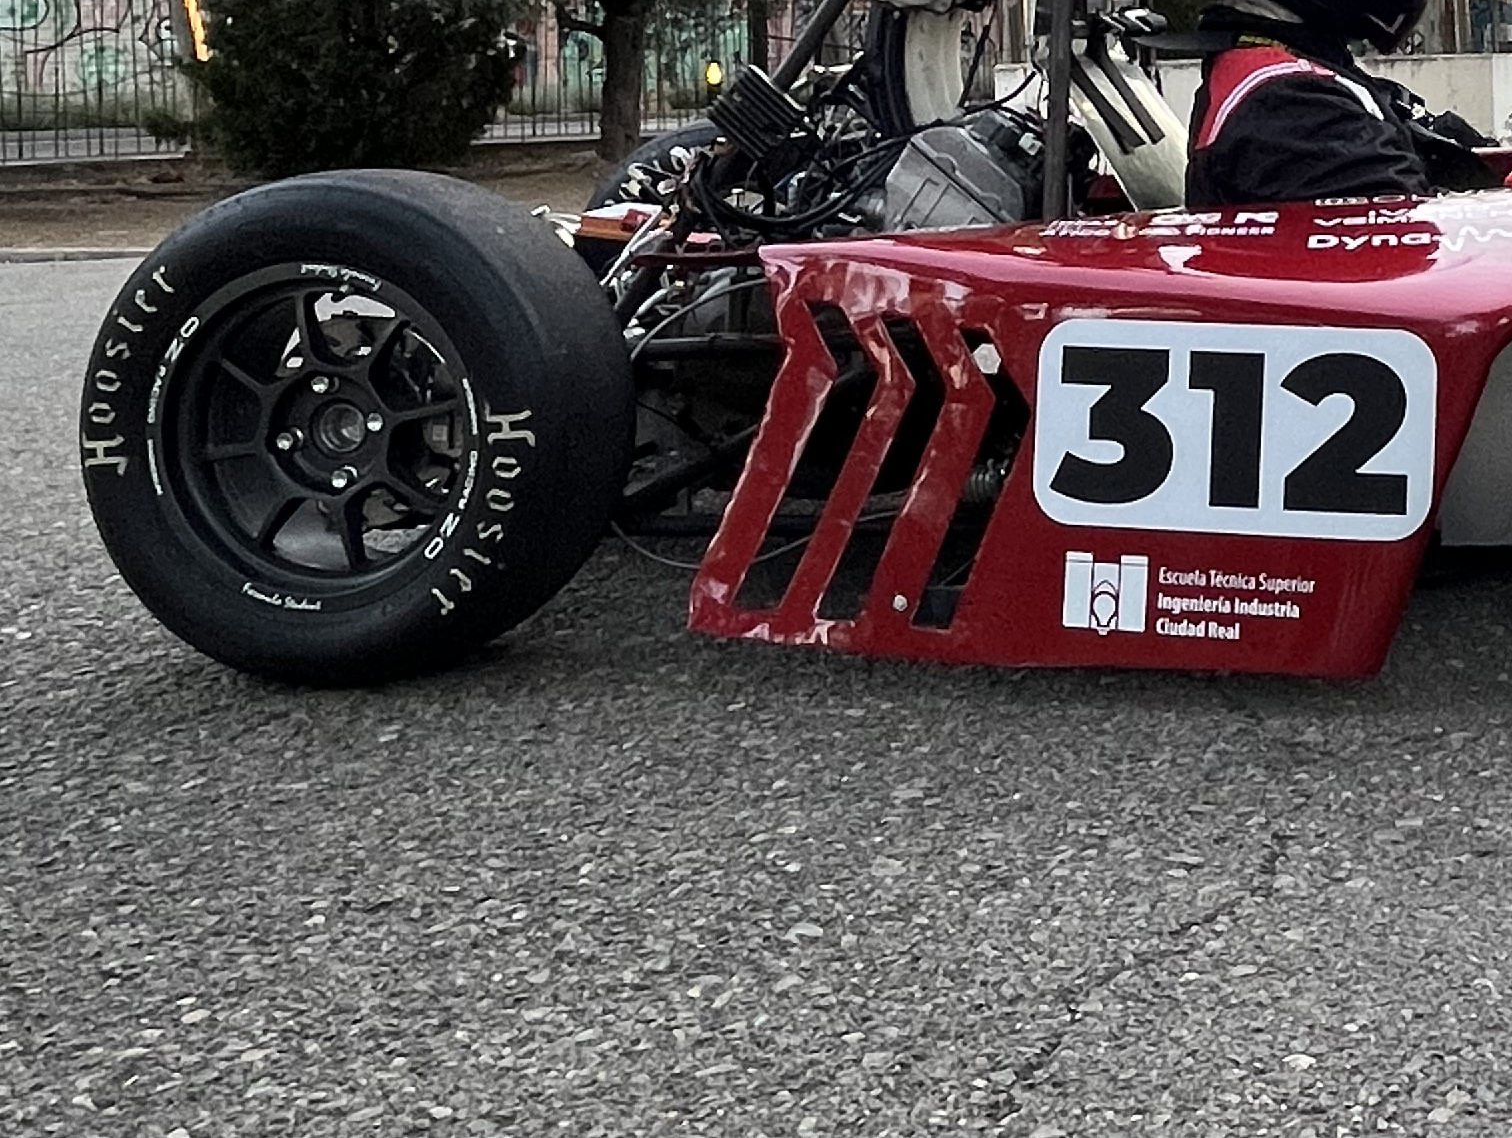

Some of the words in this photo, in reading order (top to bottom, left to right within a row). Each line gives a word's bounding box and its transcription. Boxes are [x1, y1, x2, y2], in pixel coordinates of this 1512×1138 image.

[83, 266, 176, 475] Hoosier
[1049, 345, 1409, 517] 312
[430, 407, 536, 615] Hoosier
[1156, 618, 1205, 638] Ciudad
[1208, 621, 1240, 640] Real
[1157, 593, 1231, 614] Ingeniería
[1234, 599, 1300, 619] Industria
[1159, 566, 1207, 586] Escuela
[1209, 569, 1256, 590] Técnica
[1258, 573, 1315, 594] Superior
